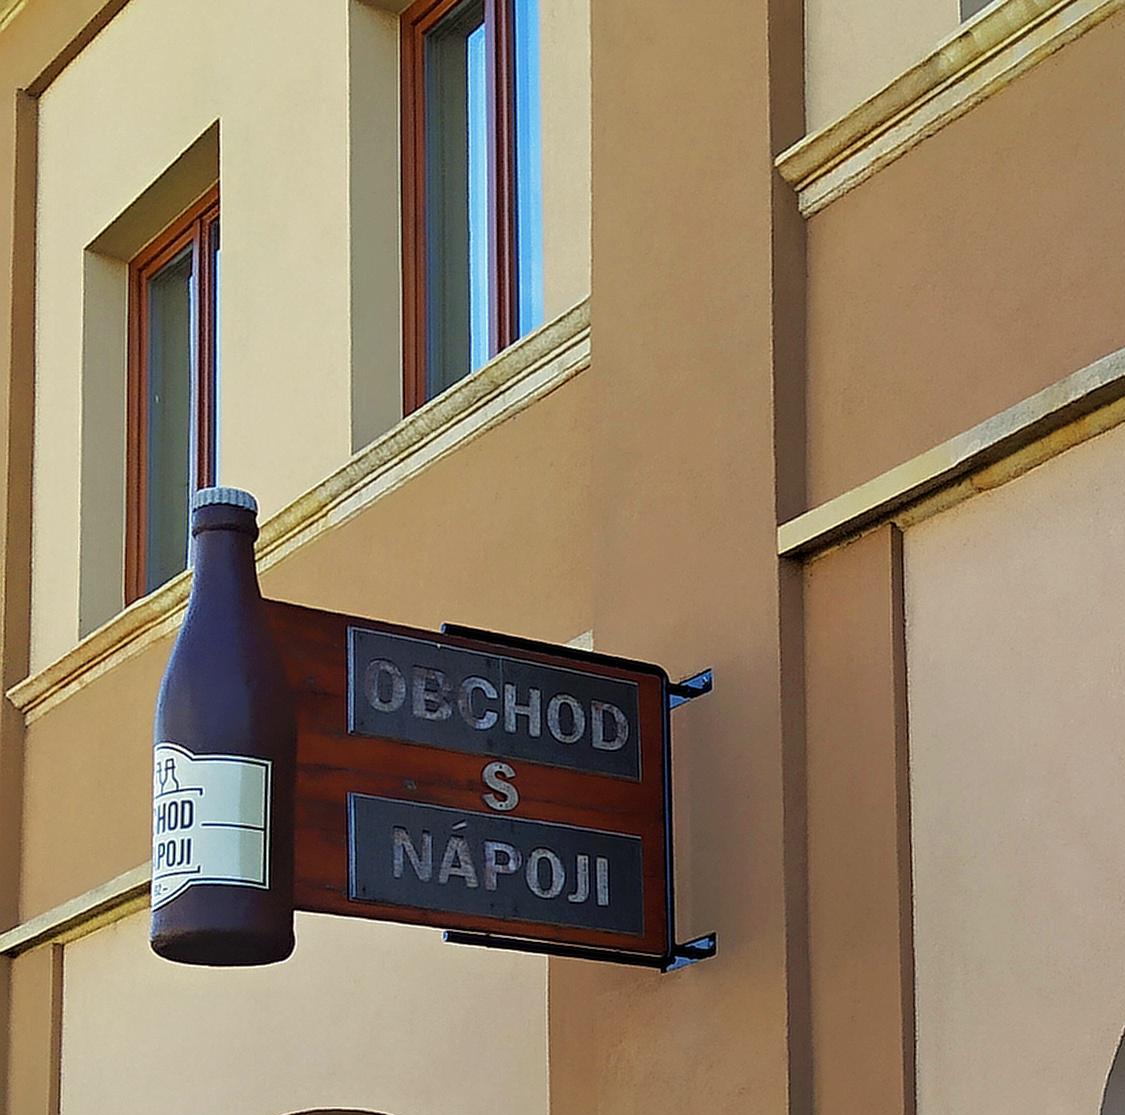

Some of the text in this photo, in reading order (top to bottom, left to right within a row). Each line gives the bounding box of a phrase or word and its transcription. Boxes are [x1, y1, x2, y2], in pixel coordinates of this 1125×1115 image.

[365, 658, 630, 751] OBCHOD
[481, 760, 520, 812] S
[155, 800, 194, 835] HOD
[154, 838, 192, 870] POJI
[392, 819, 610, 907] NÁPOJI
